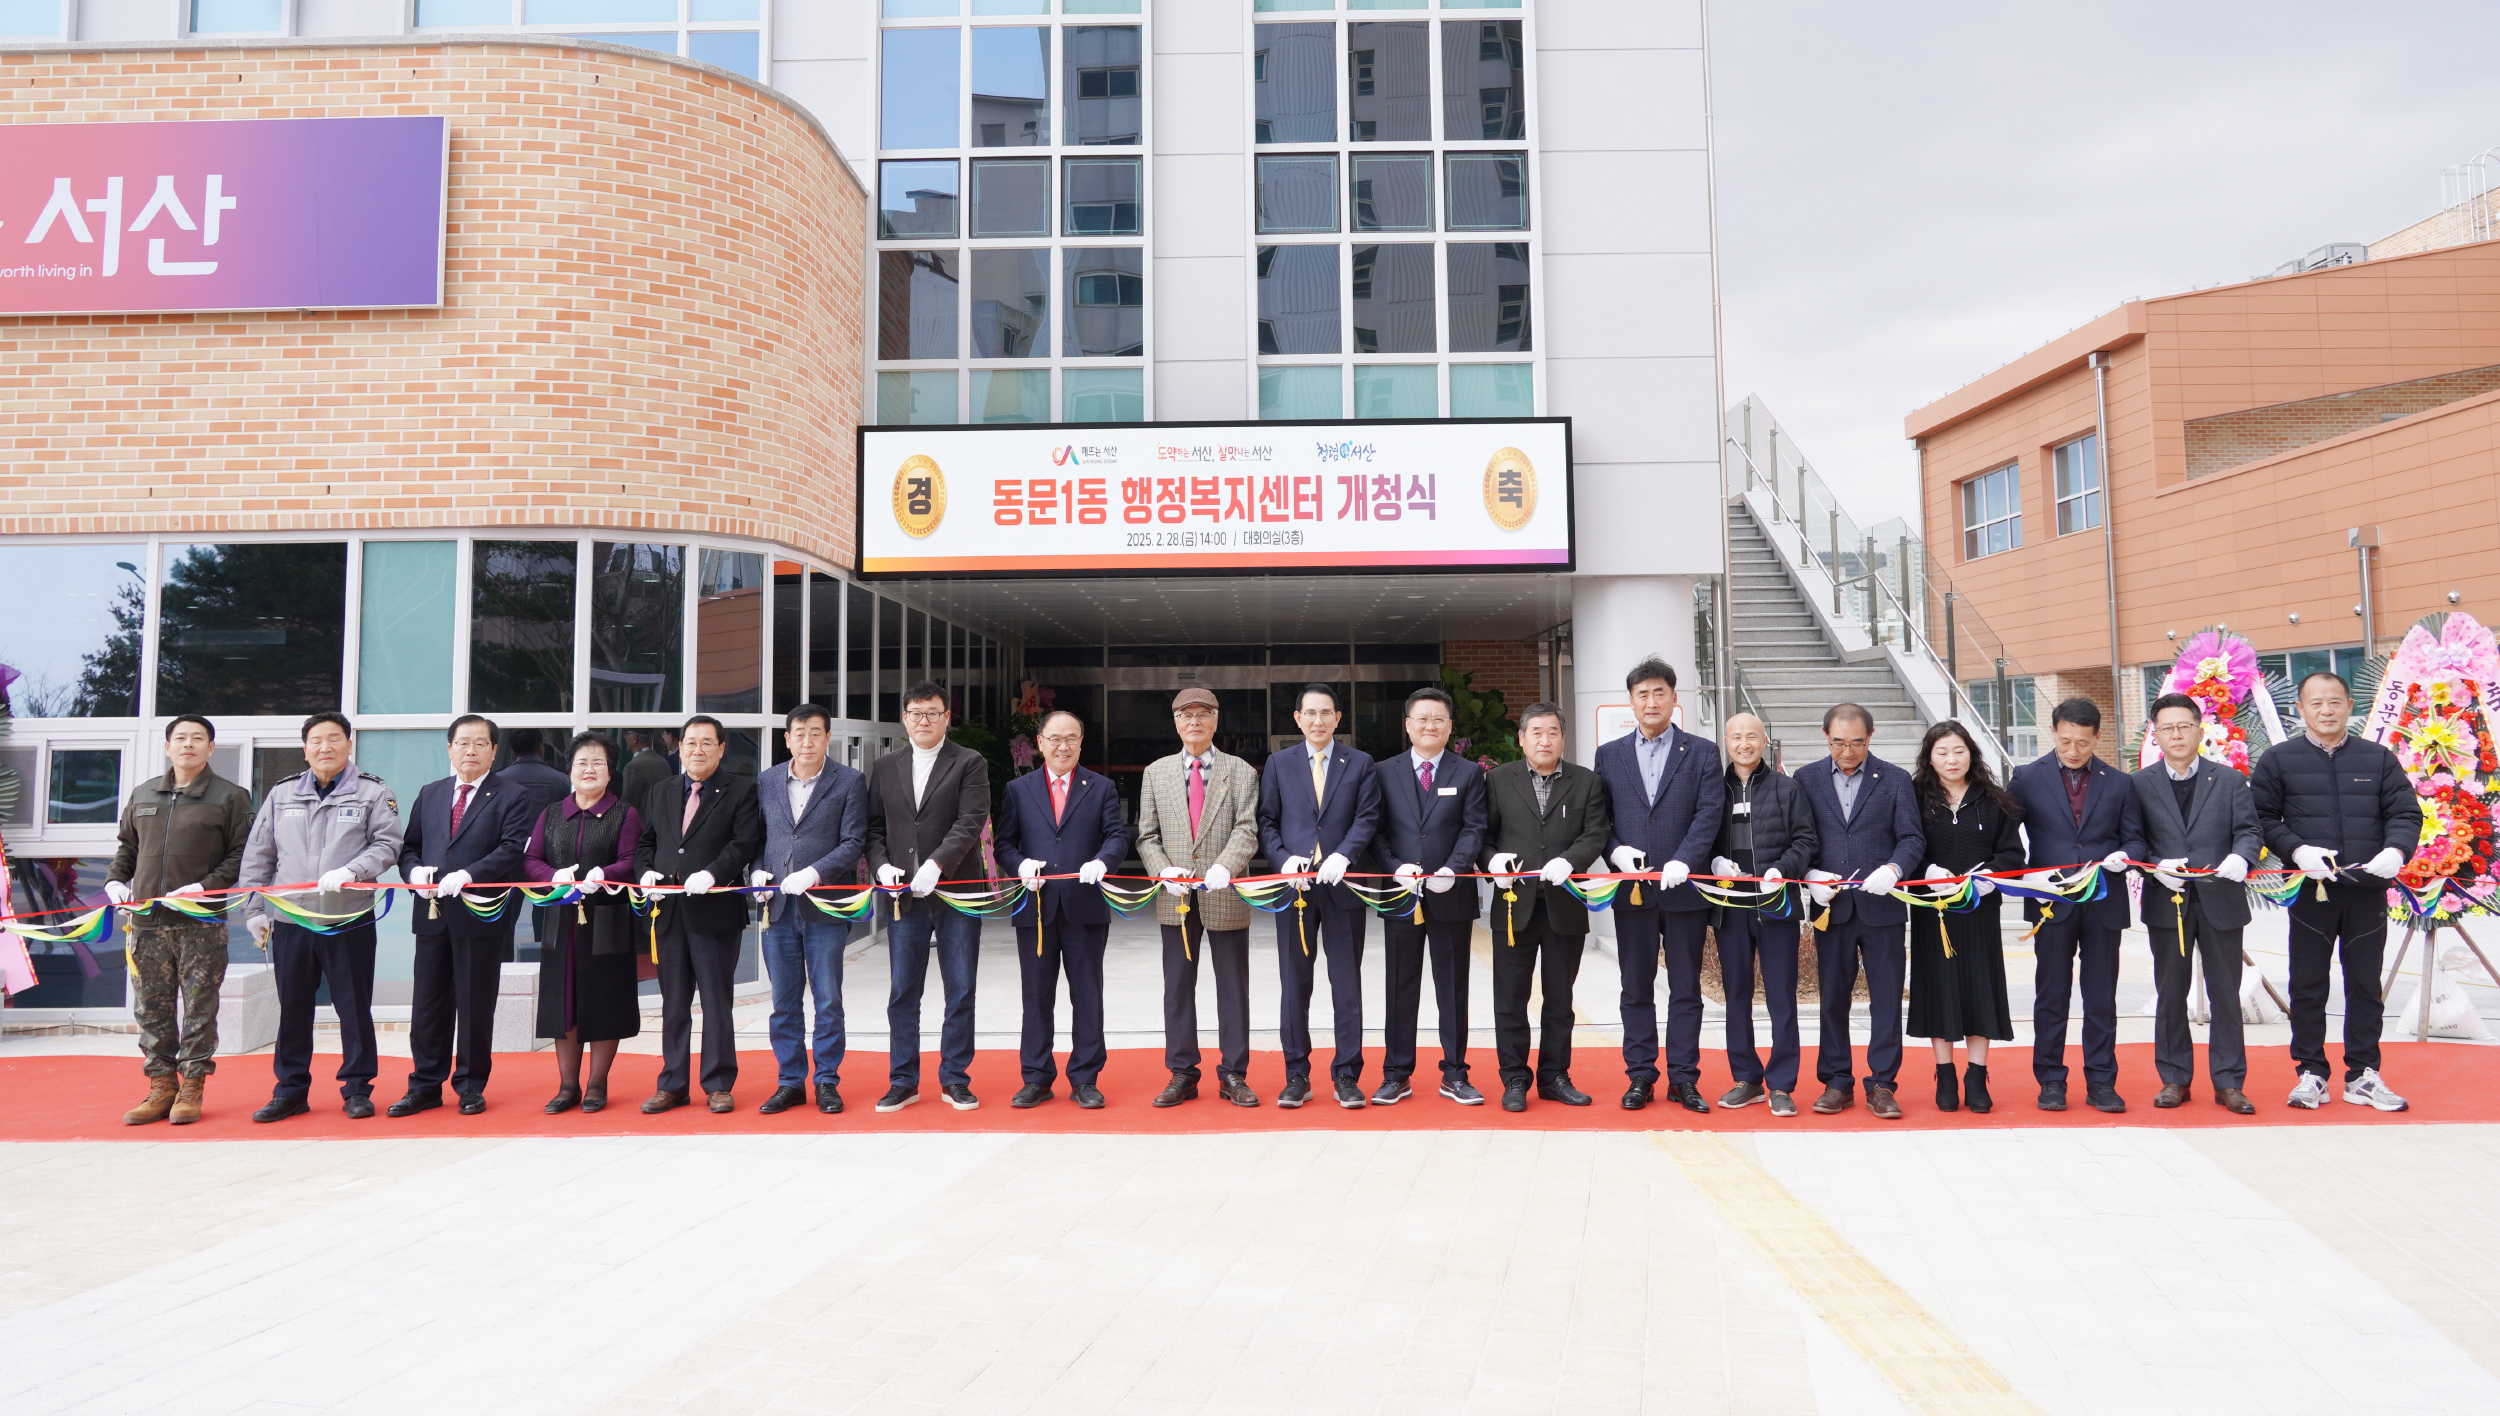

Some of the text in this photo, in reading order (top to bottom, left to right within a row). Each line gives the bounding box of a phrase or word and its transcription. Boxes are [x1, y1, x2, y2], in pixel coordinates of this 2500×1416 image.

[24, 174, 237, 277] 서산
[38, 264, 76, 280] living
[79, 263, 93, 277] in
[1081, 445, 1118, 457] 해뜨는 서산
[1157, 446, 1190, 462] 도약하는
[1218, 446, 1250, 462] 살맛나는
[1252, 445, 1273, 461] 서산
[907, 477, 932, 515] 경
[993, 473, 1436, 526] 동문1동 행정복지센터 개청식
[1498, 469, 1523, 508] 축
[1127, 532, 1154, 546] 2025.
[1156, 532, 1165, 546] 2.
[1200, 531, 1227, 546] 14:00
[1243, 530, 1304, 546] 대회의실(3층)
